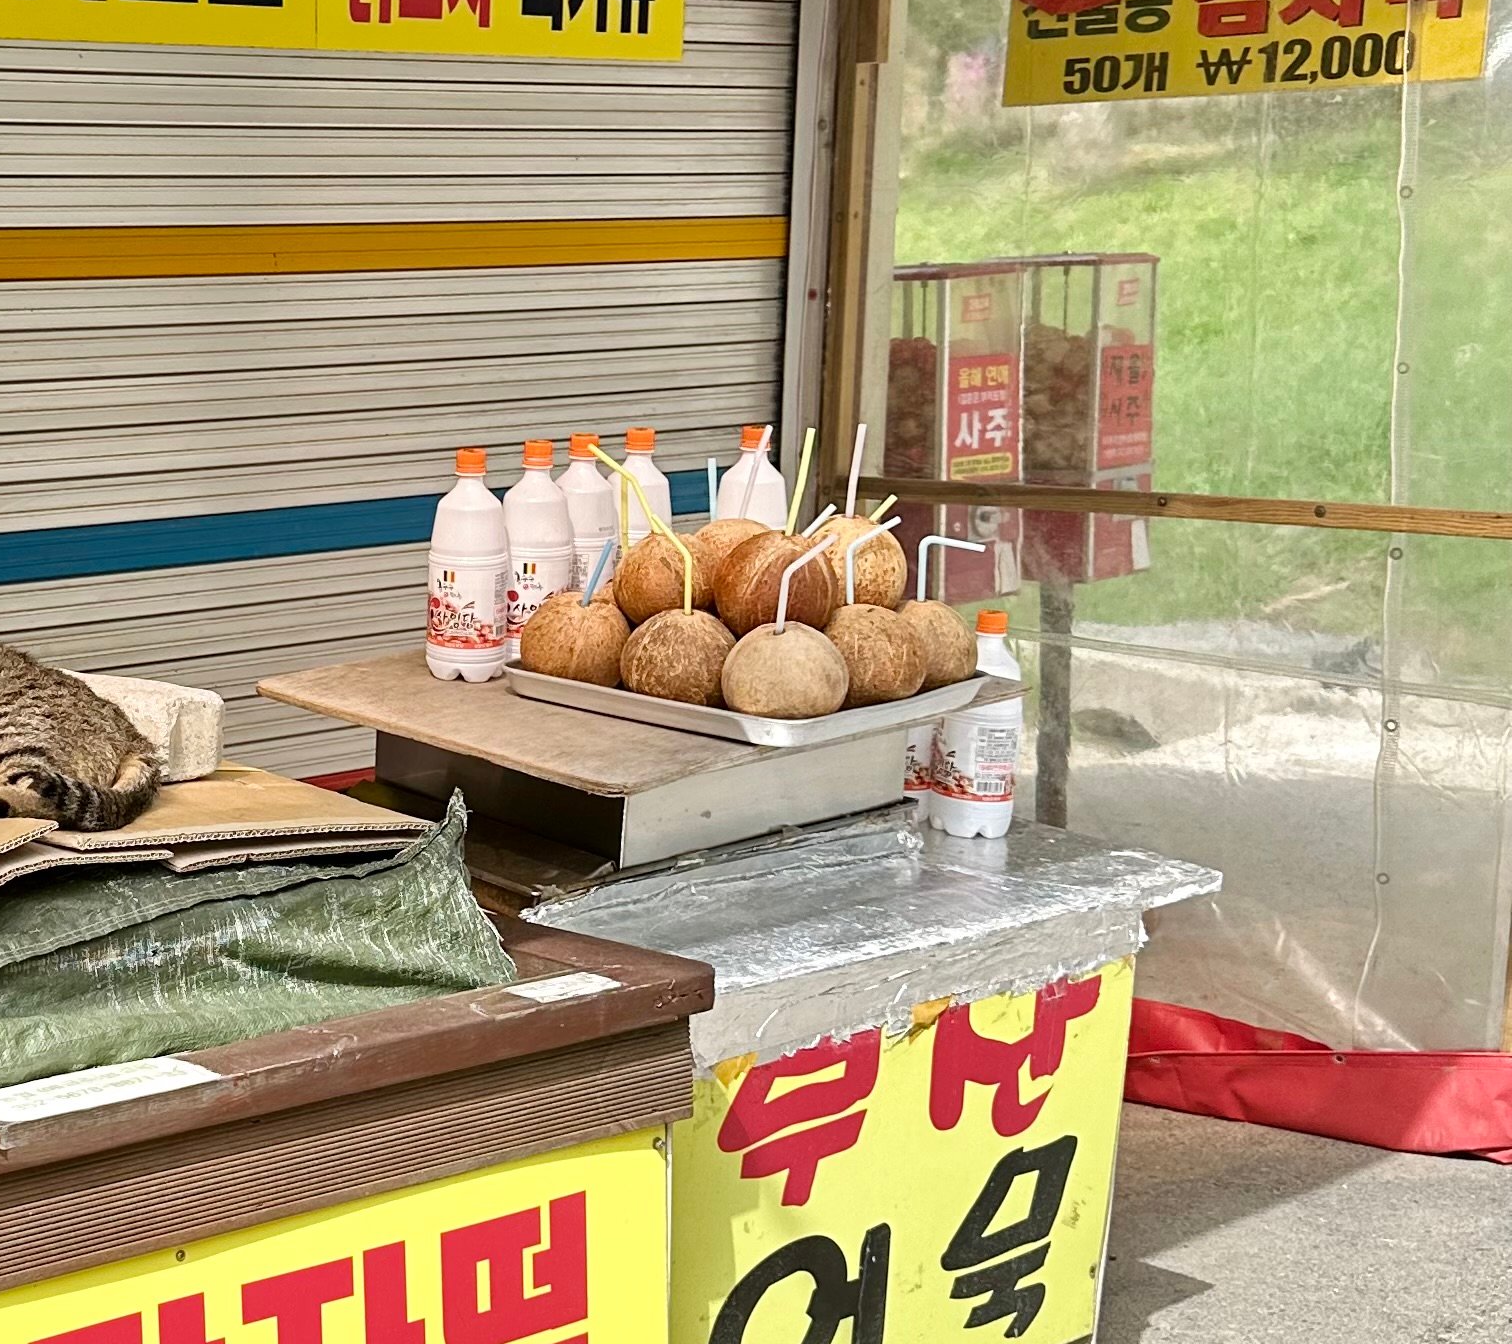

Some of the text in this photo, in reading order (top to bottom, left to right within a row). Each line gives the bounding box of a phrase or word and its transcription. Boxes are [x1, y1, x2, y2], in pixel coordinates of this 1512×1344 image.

[1063, 52, 1169, 96] 50개
[954, 408, 1011, 449] 사주
[717, 975, 1102, 1207] 부산
